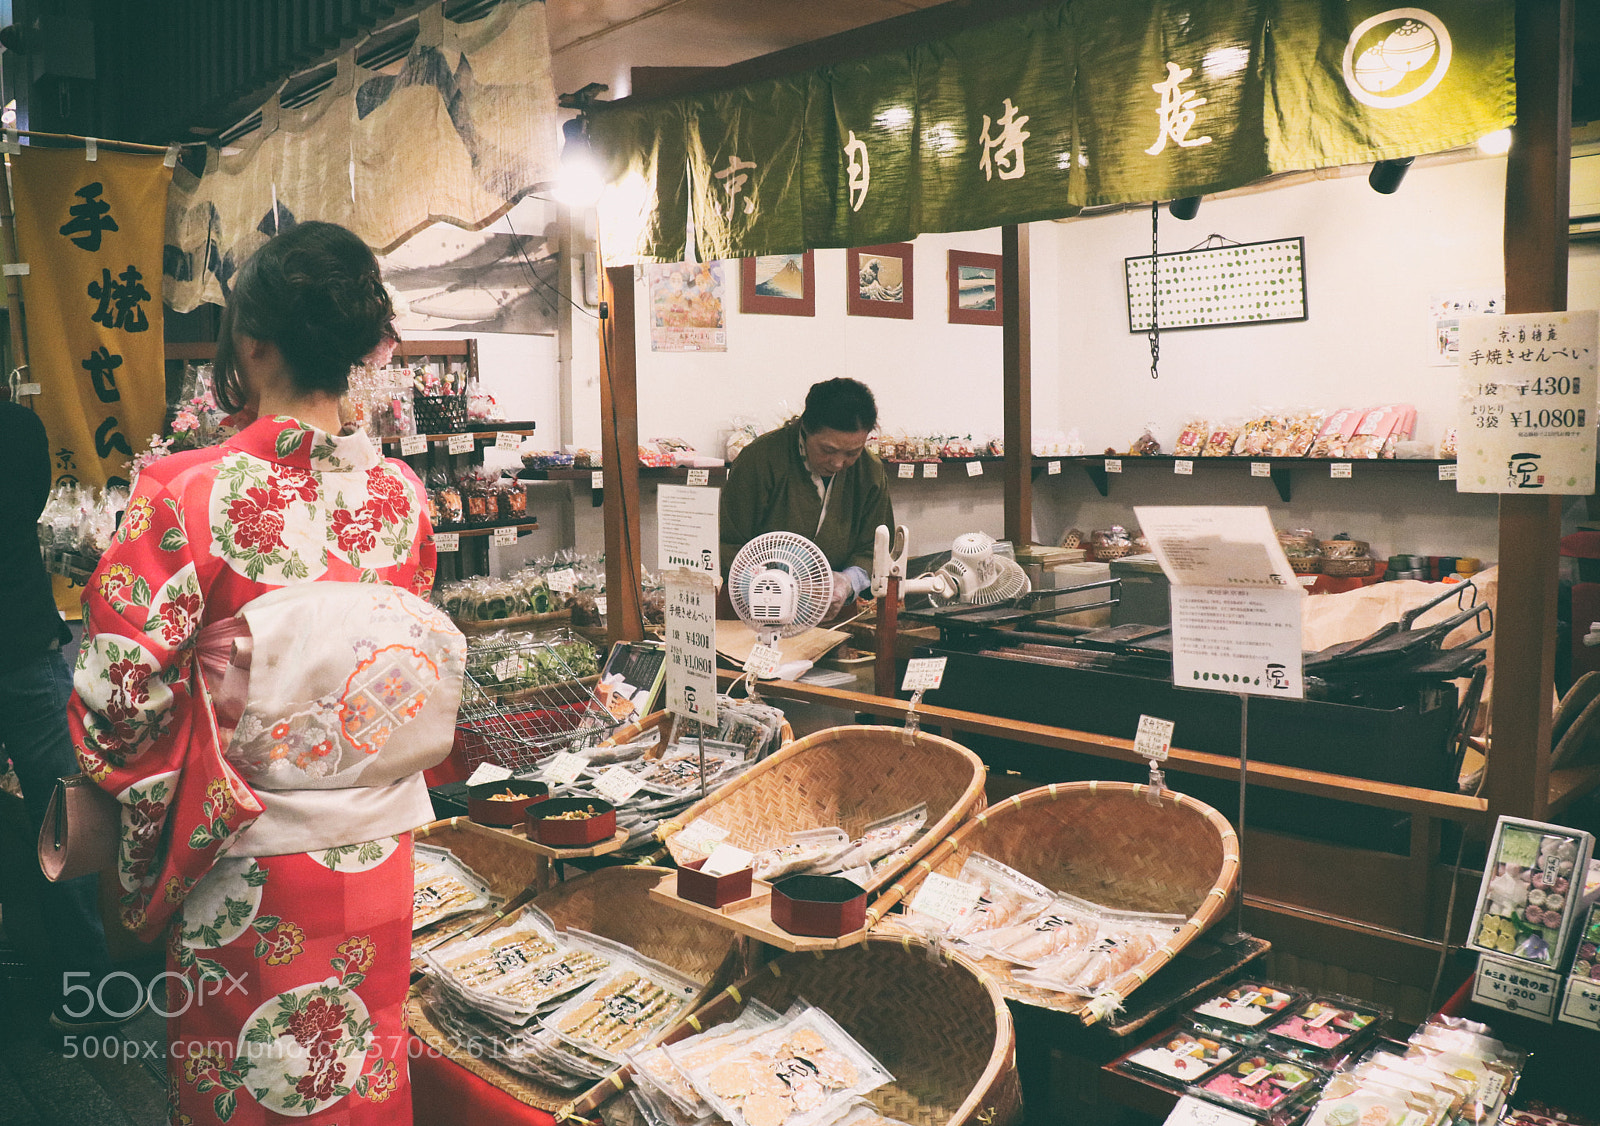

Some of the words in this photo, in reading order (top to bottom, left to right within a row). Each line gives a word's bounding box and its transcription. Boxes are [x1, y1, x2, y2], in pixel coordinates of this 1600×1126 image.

[1468, 347, 1589, 366] 手焼きせんべい
[1476, 416, 1499, 429] 3袋
[1510, 408, 1576, 429] ¥1,080
[685, 631, 706, 649] ¥430
[683, 654, 708, 674] ¥1,080
